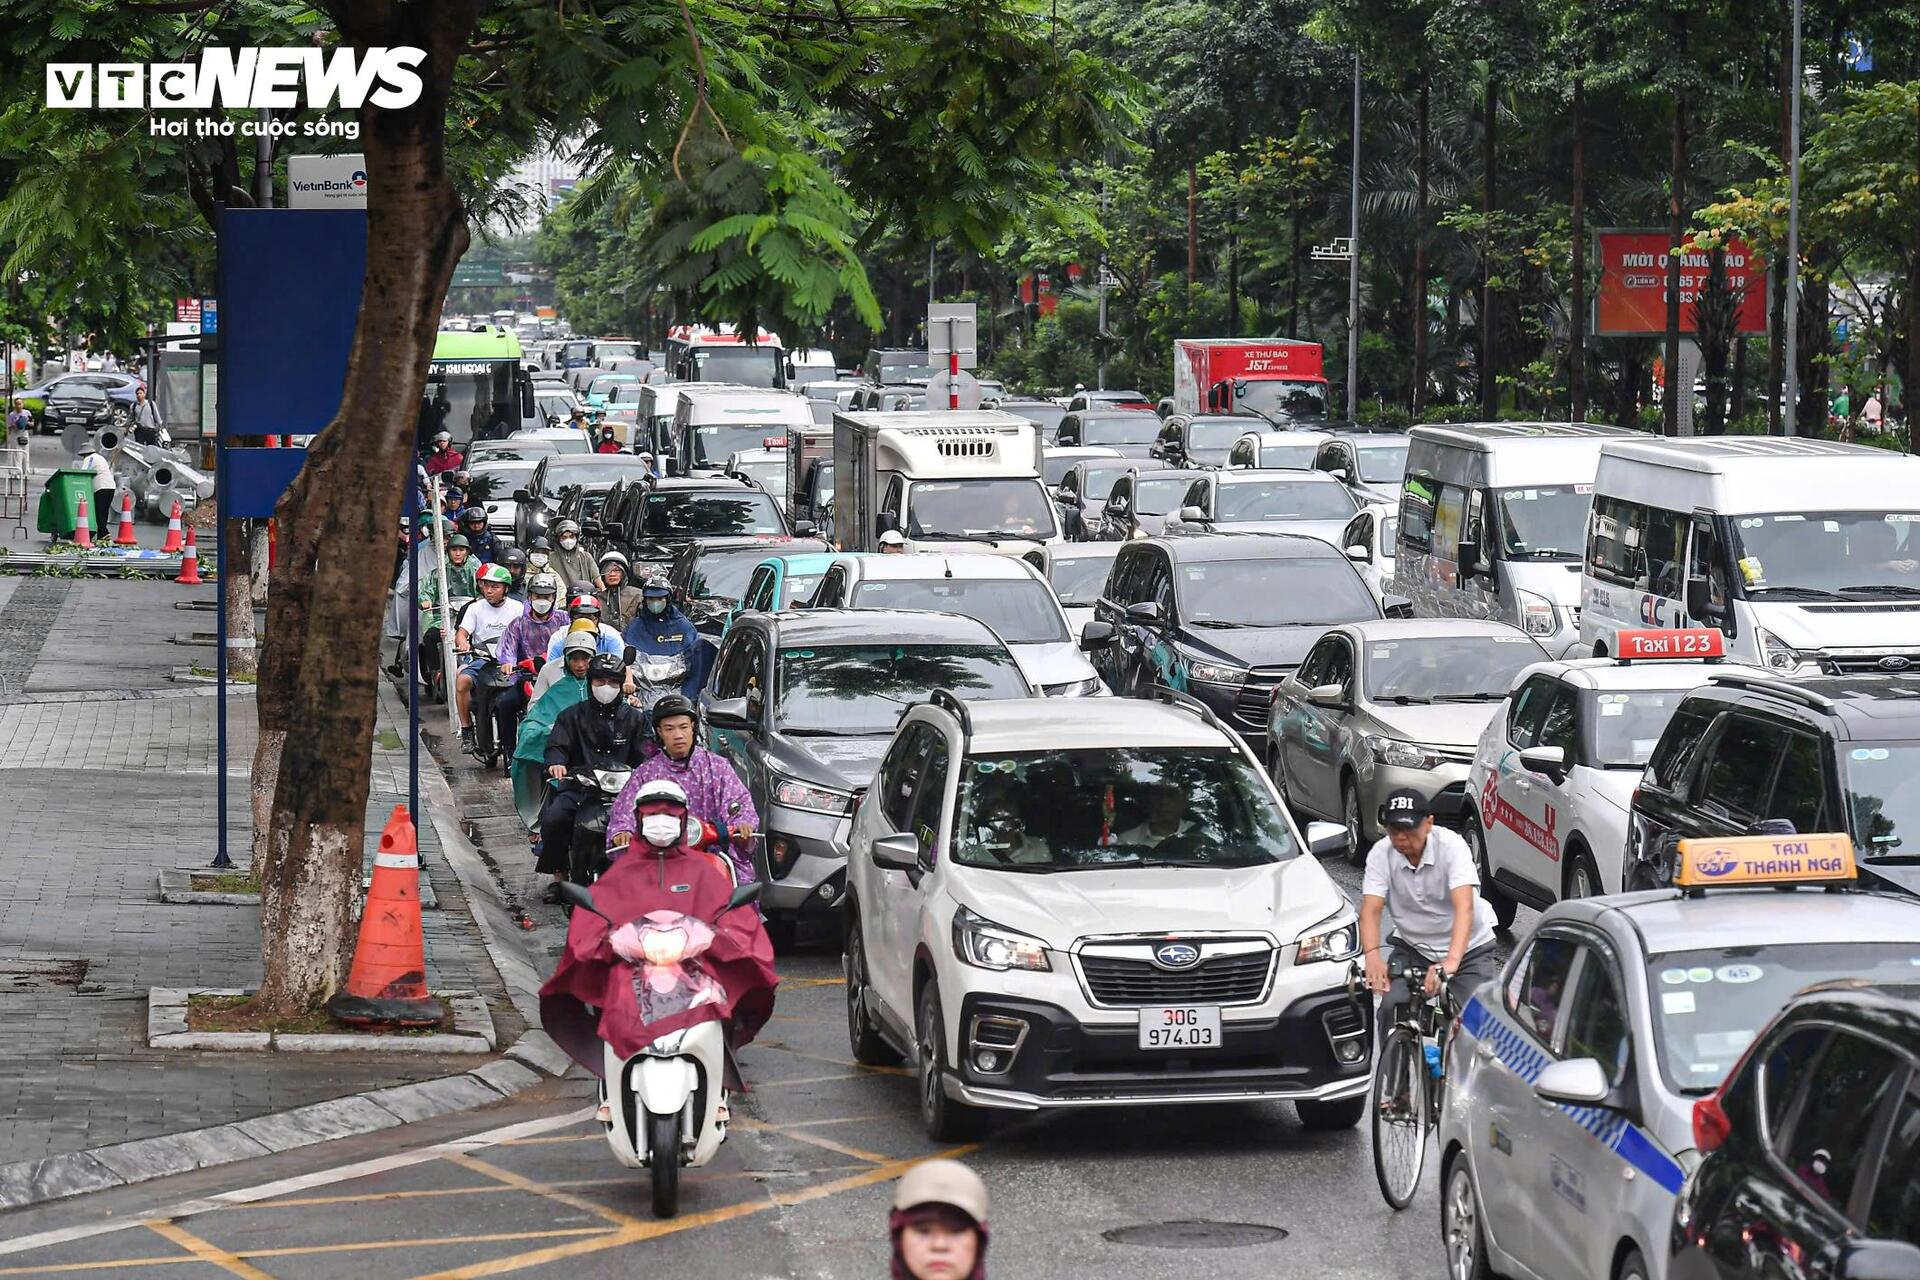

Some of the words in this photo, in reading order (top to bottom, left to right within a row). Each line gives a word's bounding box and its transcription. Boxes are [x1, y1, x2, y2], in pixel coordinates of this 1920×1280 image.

[293, 180, 353, 192] VietinBank
[1622, 252, 1654, 267] MỜI
[1245, 360, 1272, 371] J&T
[766, 437, 784, 446] Taxi
[1632, 635, 1669, 653] Taxi
[1673, 634, 1711, 652] 123
[1885, 657, 1905, 668] Ford
[1389, 796, 1414, 810] FBI
[1773, 843, 1809, 856] TAXI
[1744, 861, 1801, 875] THANH
[1807, 858, 1842, 872] NGA
[1163, 1009, 1197, 1026] 30G
[1149, 1028, 1212, 1046] 974.03
